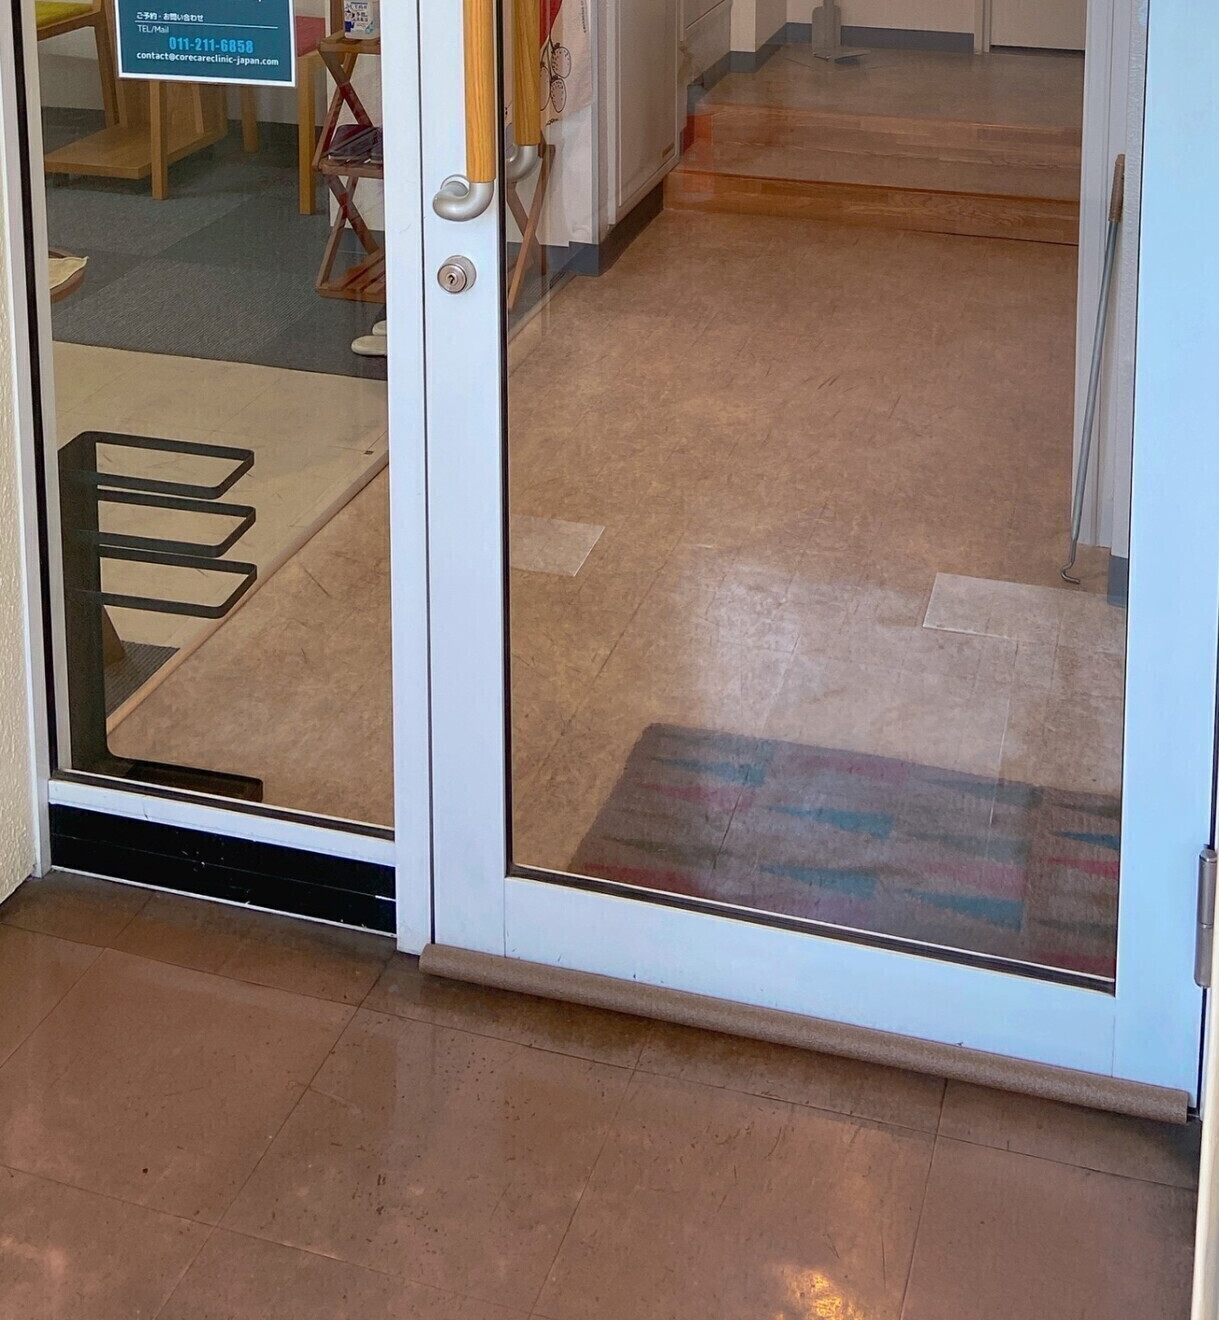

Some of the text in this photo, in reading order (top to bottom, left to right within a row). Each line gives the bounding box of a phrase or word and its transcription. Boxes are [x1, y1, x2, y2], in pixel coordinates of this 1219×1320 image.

[138, 24, 170, 34] TEL/Mail
[169, 36, 254, 54] 011-211-6858
[136, 51, 279, 66] contact@corecareclinic-japan.com
